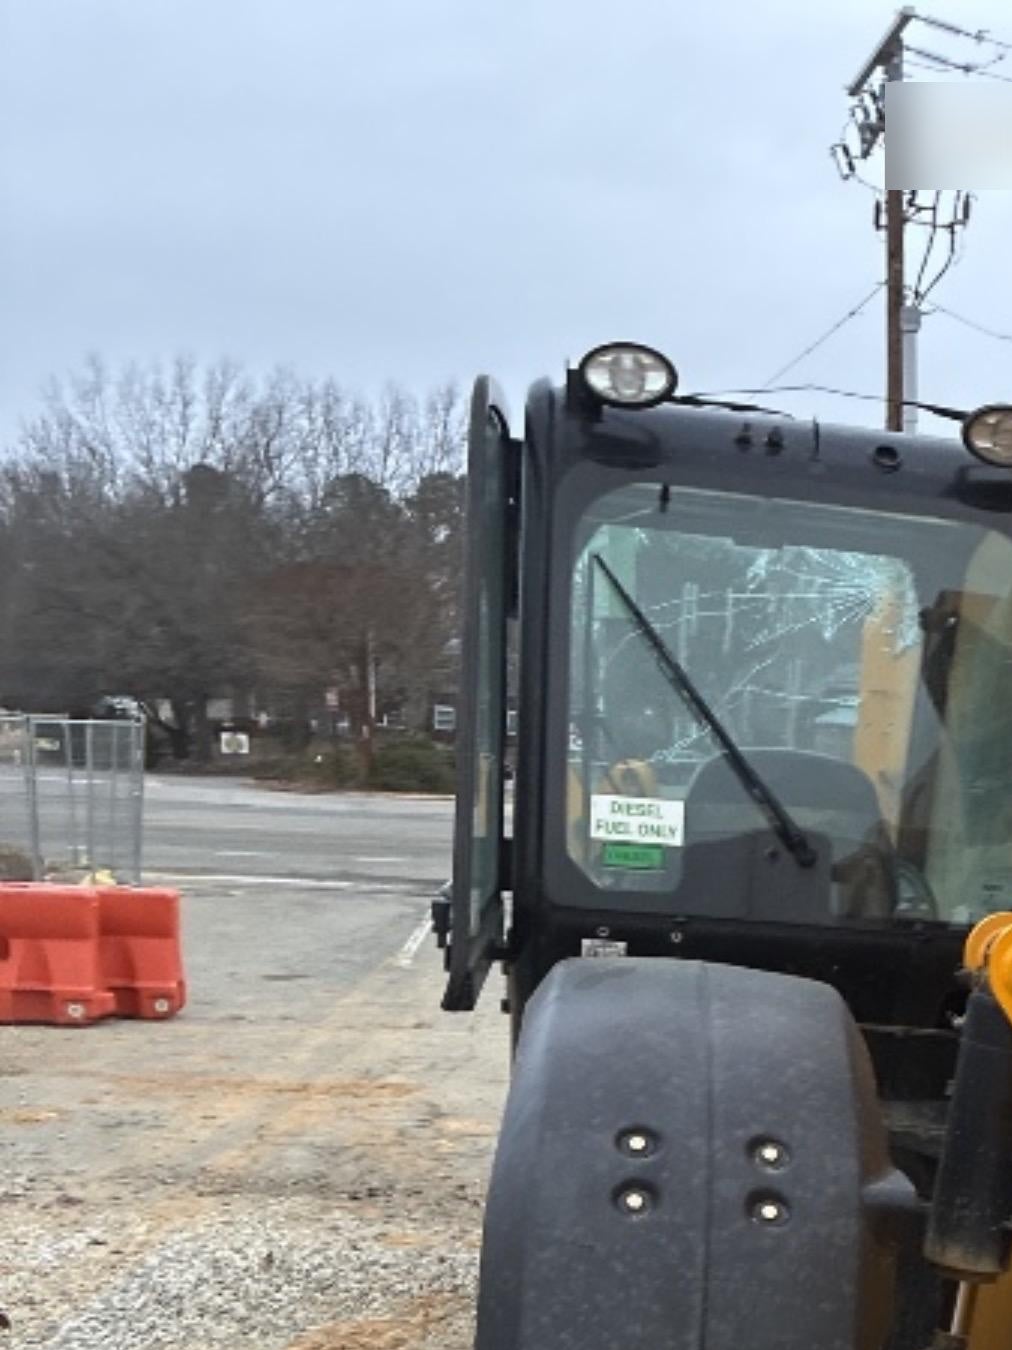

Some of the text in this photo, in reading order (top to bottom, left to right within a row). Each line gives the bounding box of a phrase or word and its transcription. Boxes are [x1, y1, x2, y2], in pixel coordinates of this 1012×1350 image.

[611, 801, 663, 819] DIESEL
[596, 819, 677, 839] FUEL ONLY
